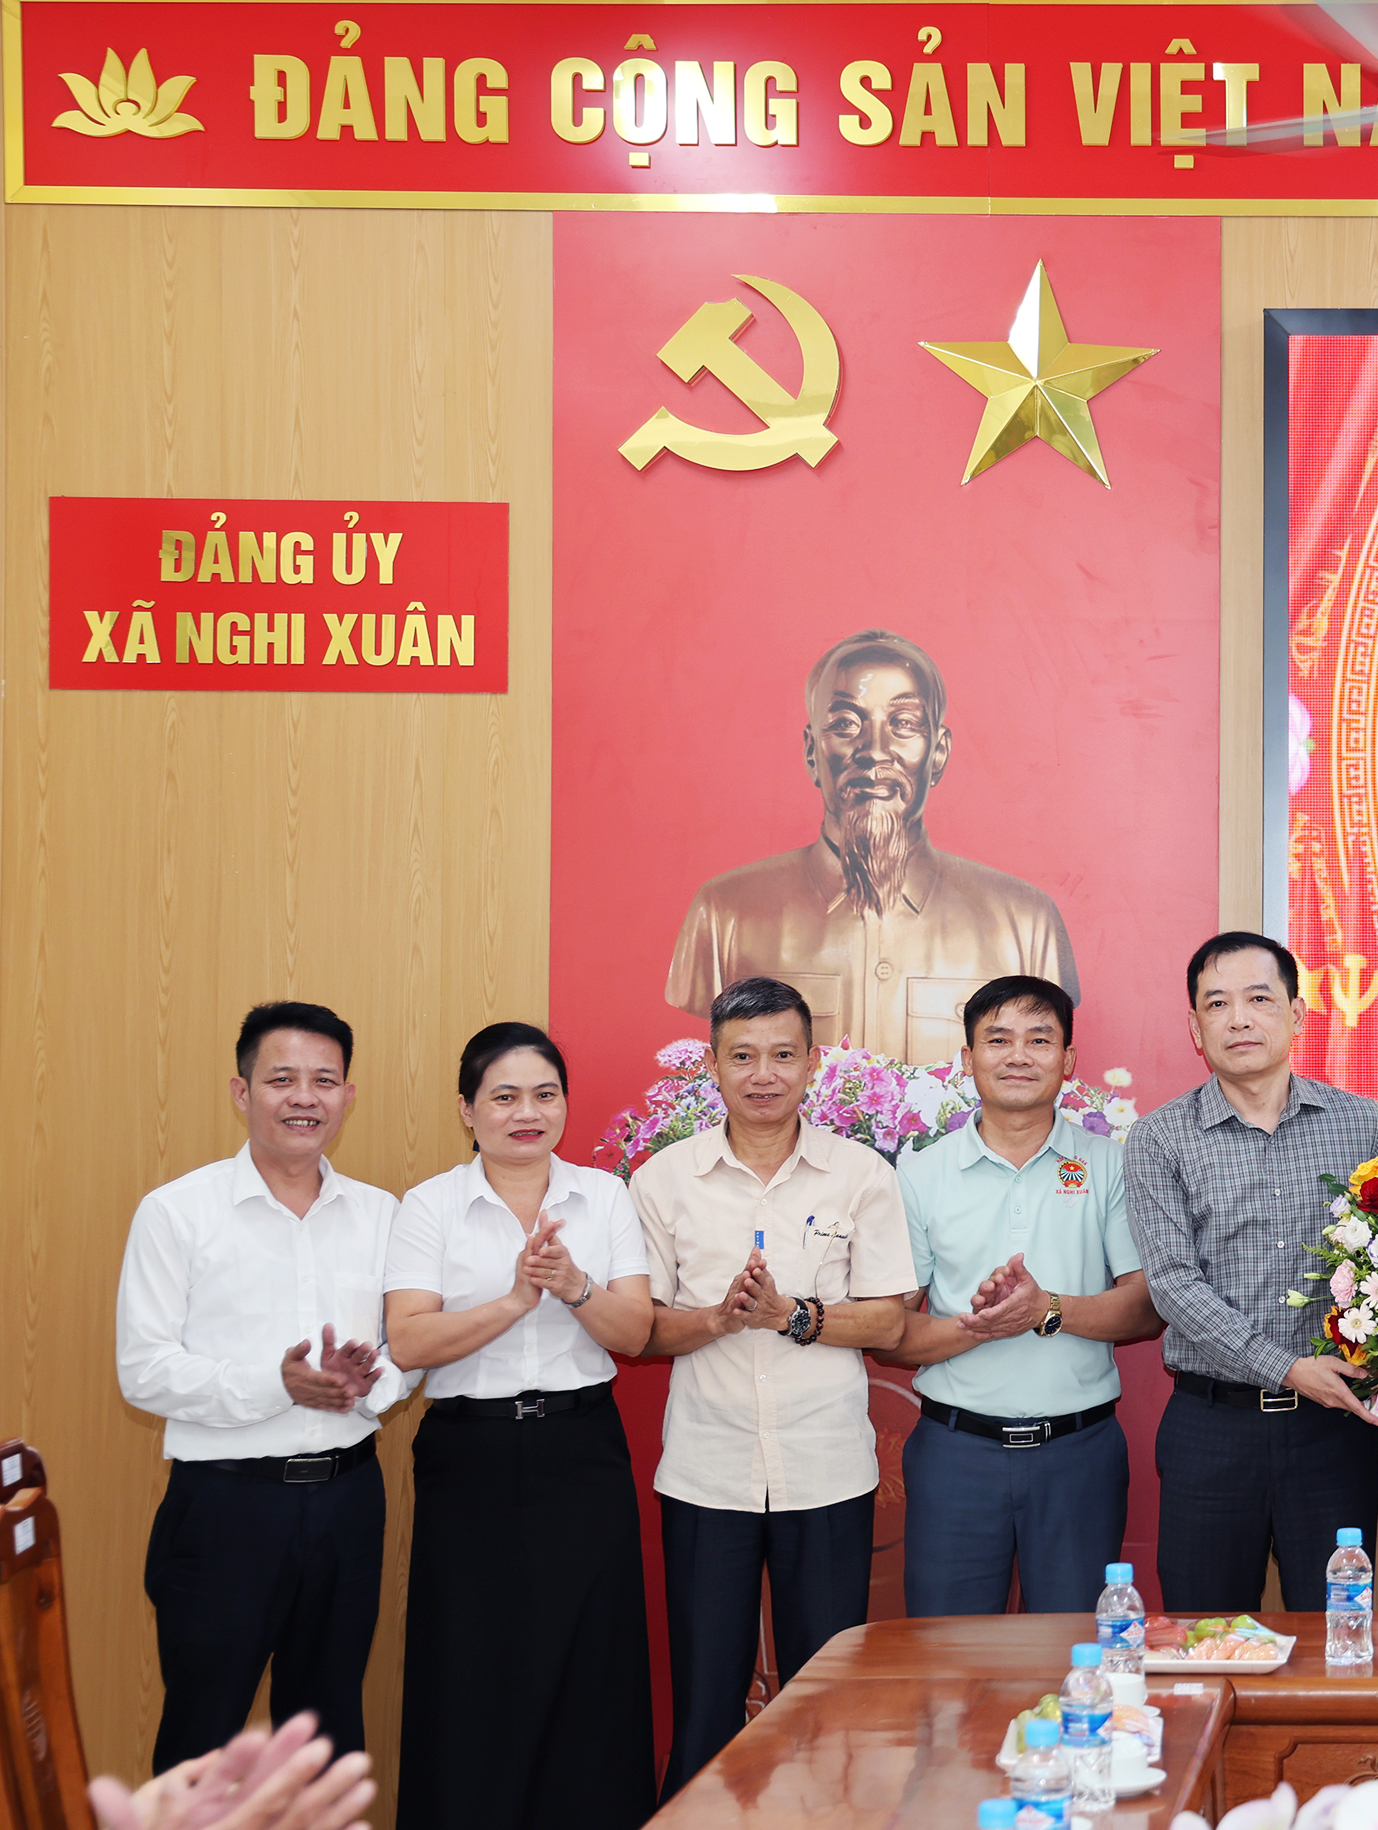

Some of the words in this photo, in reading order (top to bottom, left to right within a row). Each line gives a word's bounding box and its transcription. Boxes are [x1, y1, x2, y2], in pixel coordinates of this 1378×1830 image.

[250, 20, 509, 145] ĐẢNG
[551, 33, 799, 167] CỘNG
[838, 26, 1026, 147] SẢN
[1070, 38, 1260, 169] VIỆT
[159, 511, 314, 584] ĐẢNG
[332, 511, 404, 585] ỦY
[82, 599, 161, 664] XÃ
[176, 612, 305, 665] NGHI
[322, 601, 475, 666] XUÂN
